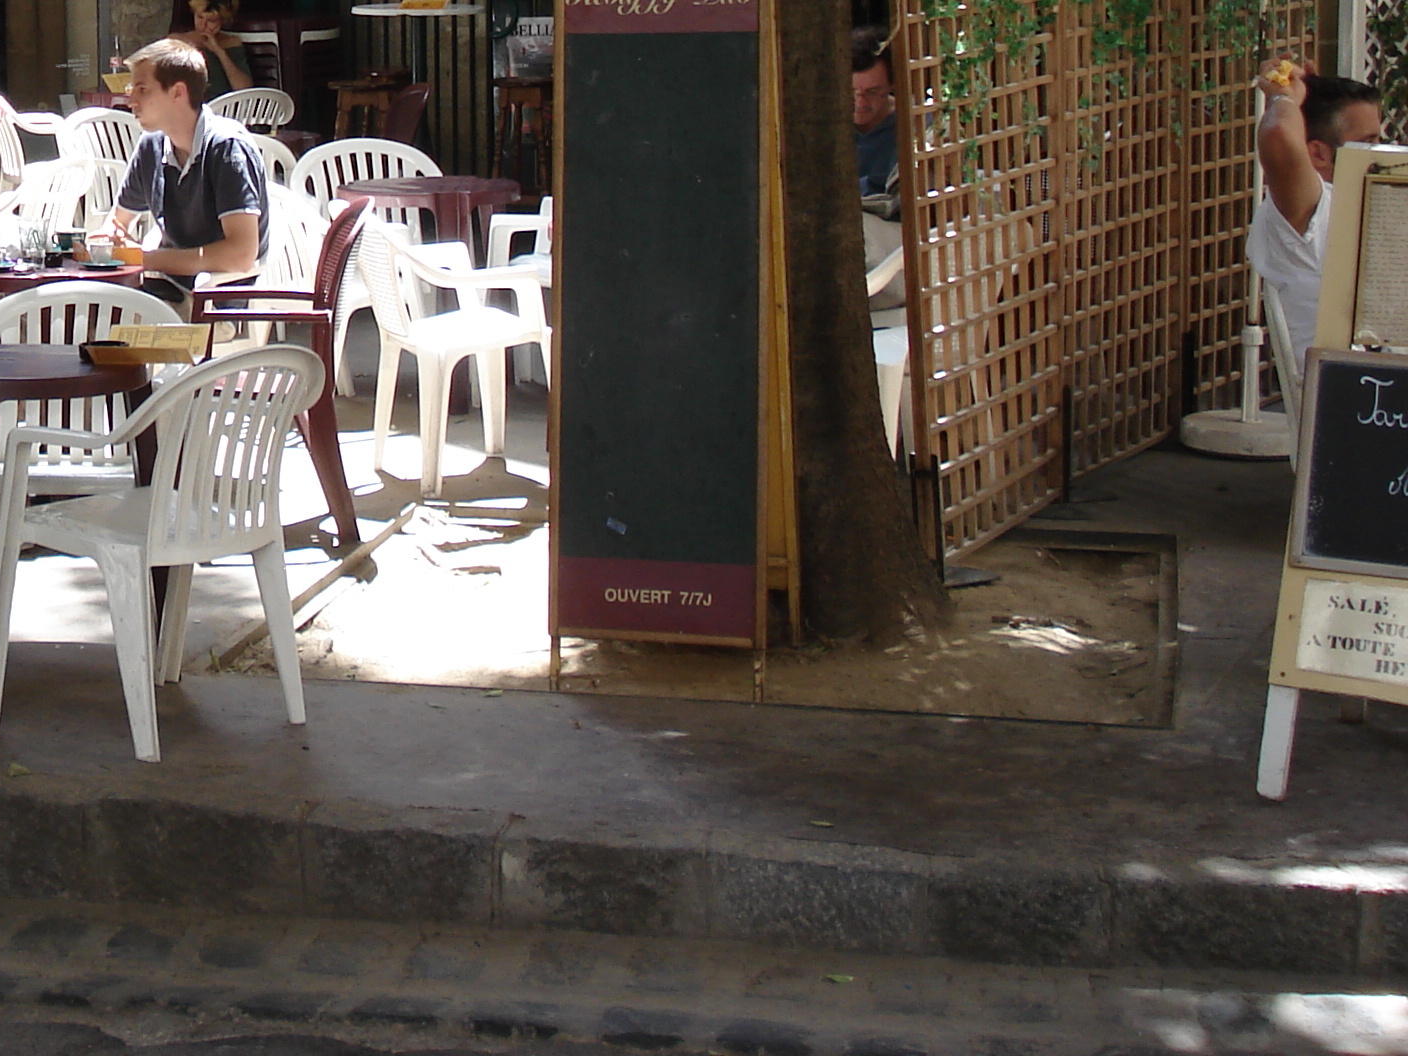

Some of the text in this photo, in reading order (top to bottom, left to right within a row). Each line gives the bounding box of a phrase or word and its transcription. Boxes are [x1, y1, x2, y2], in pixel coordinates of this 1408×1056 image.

[604, 588, 713, 607] OUVERT 7/7J
[1327, 635, 1395, 657] TOUTE
